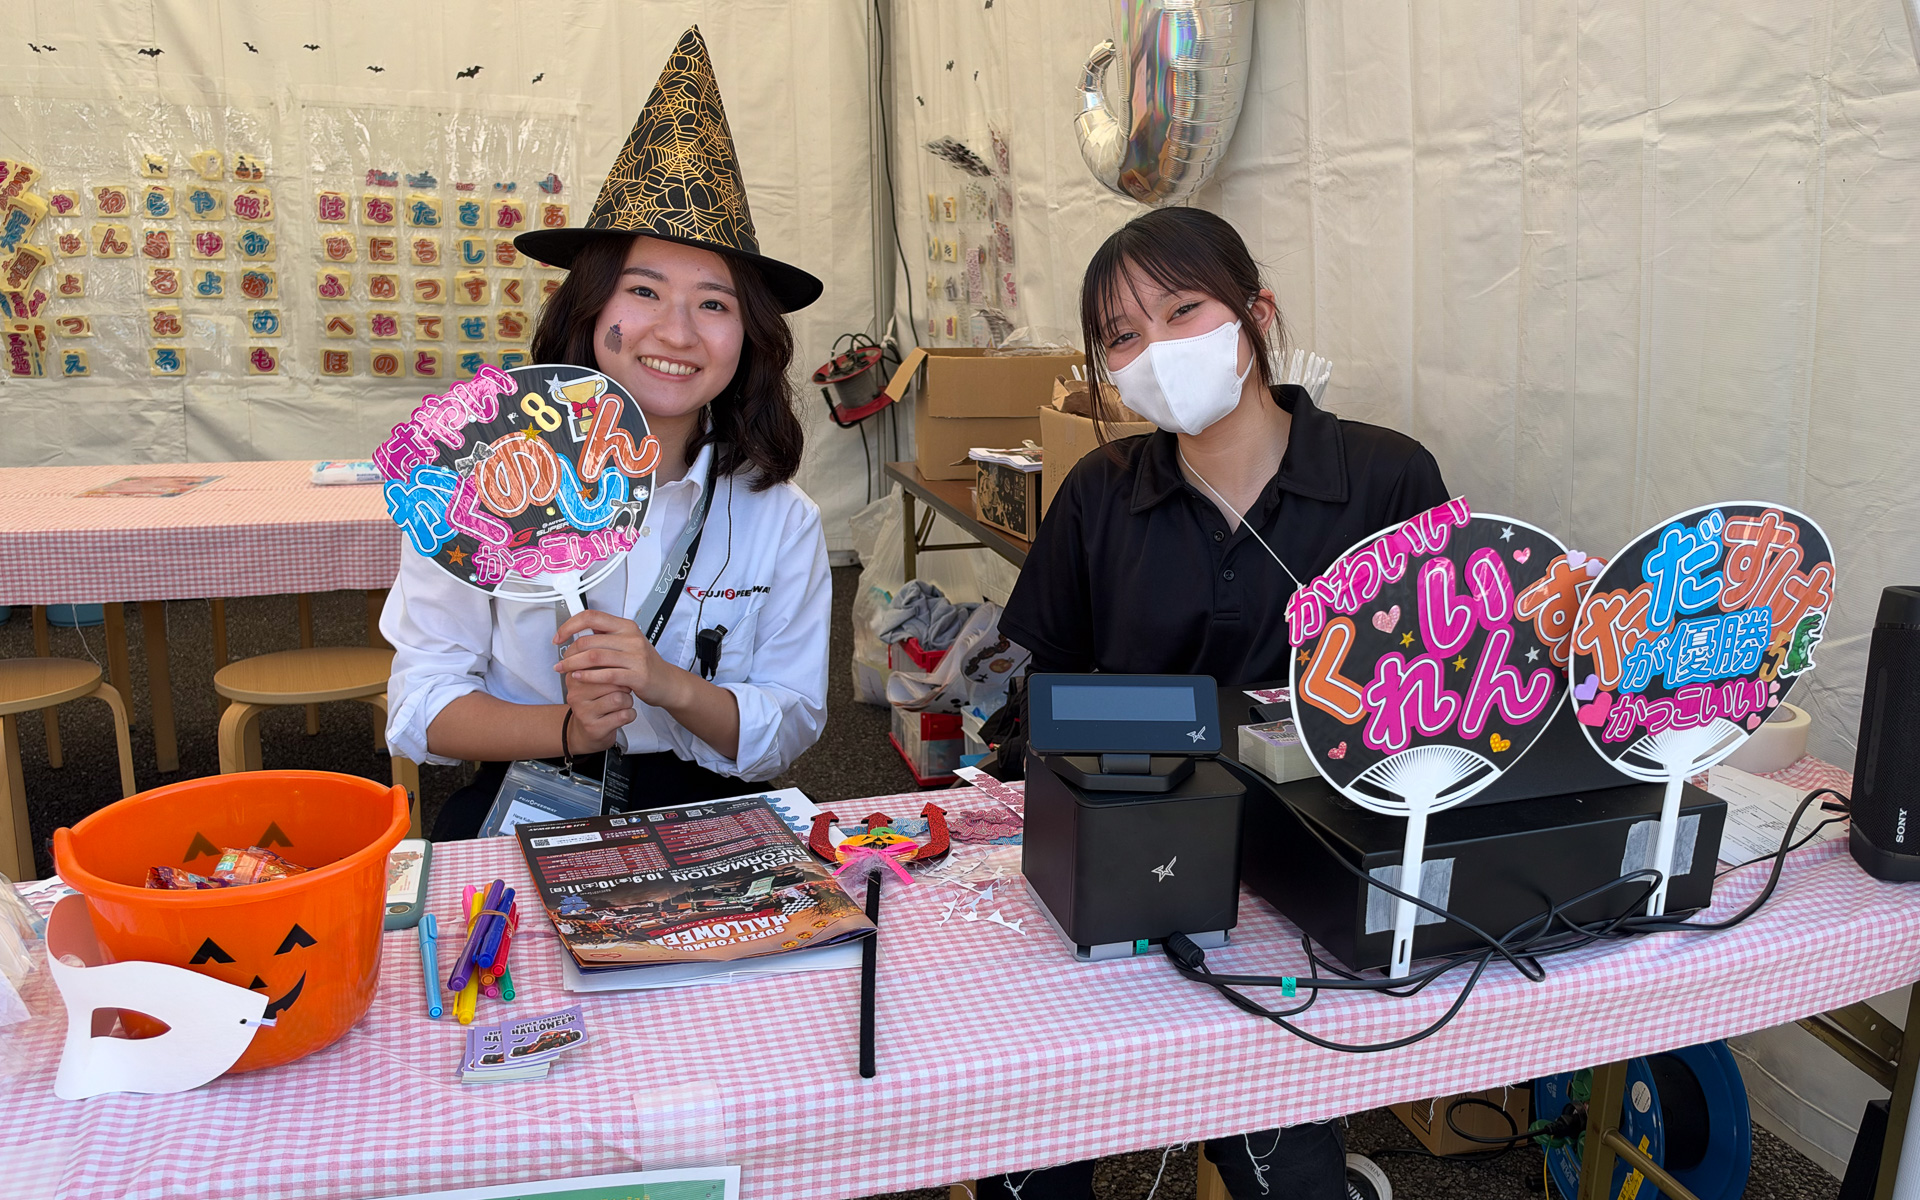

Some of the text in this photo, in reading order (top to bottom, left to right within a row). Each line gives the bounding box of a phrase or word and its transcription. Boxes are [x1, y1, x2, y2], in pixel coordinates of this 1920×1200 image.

[98, 188, 126, 214] わ
[190, 190, 216, 214] や
[320, 195, 346, 221] は
[367, 198, 393, 224] な
[411, 201, 437, 226] た
[459, 201, 480, 226] さ
[498, 205, 522, 228] か
[544, 205, 567, 228] あ
[100, 228, 128, 254] ん
[243, 231, 270, 256] み
[370, 237, 395, 260] に
[413, 239, 437, 263] ち
[463, 240, 485, 264] し
[496, 241, 517, 265] き
[197, 270, 222, 295] よ
[319, 274, 345, 298] ふ
[370, 275, 395, 298] ぬ
[416, 279, 441, 300] つ
[464, 278, 487, 302] す
[505, 280, 521, 303] く
[252, 310, 278, 334] め
[327, 316, 354, 336] へ
[371, 313, 398, 337] ね
[418, 316, 441, 338] て
[461, 317, 486, 339] せ
[251, 348, 275, 372] も
[324, 352, 348, 373] ほ
[373, 353, 398, 373] の
[415, 351, 435, 374] と
[372, 364, 518, 484] はやい
[521, 392, 562, 432] 8
[1285, 495, 1470, 647] かわいい
[1618, 606, 1772, 694] が優勝
[1759, 631, 1791, 682] 5
[1602, 677, 1768, 743] かっこいい
[1896, 808, 1908, 843] SONY
[671, 848, 807, 882] INFORMATION
[752, 856, 813, 874] EVENT
[647, 914, 790, 946] HALLOWEEN
[738, 925, 785, 942] SUPER
[511, 1016, 575, 1035] HALLOWEEN
[515, 1013, 570, 1029] SUPER FORMULA
